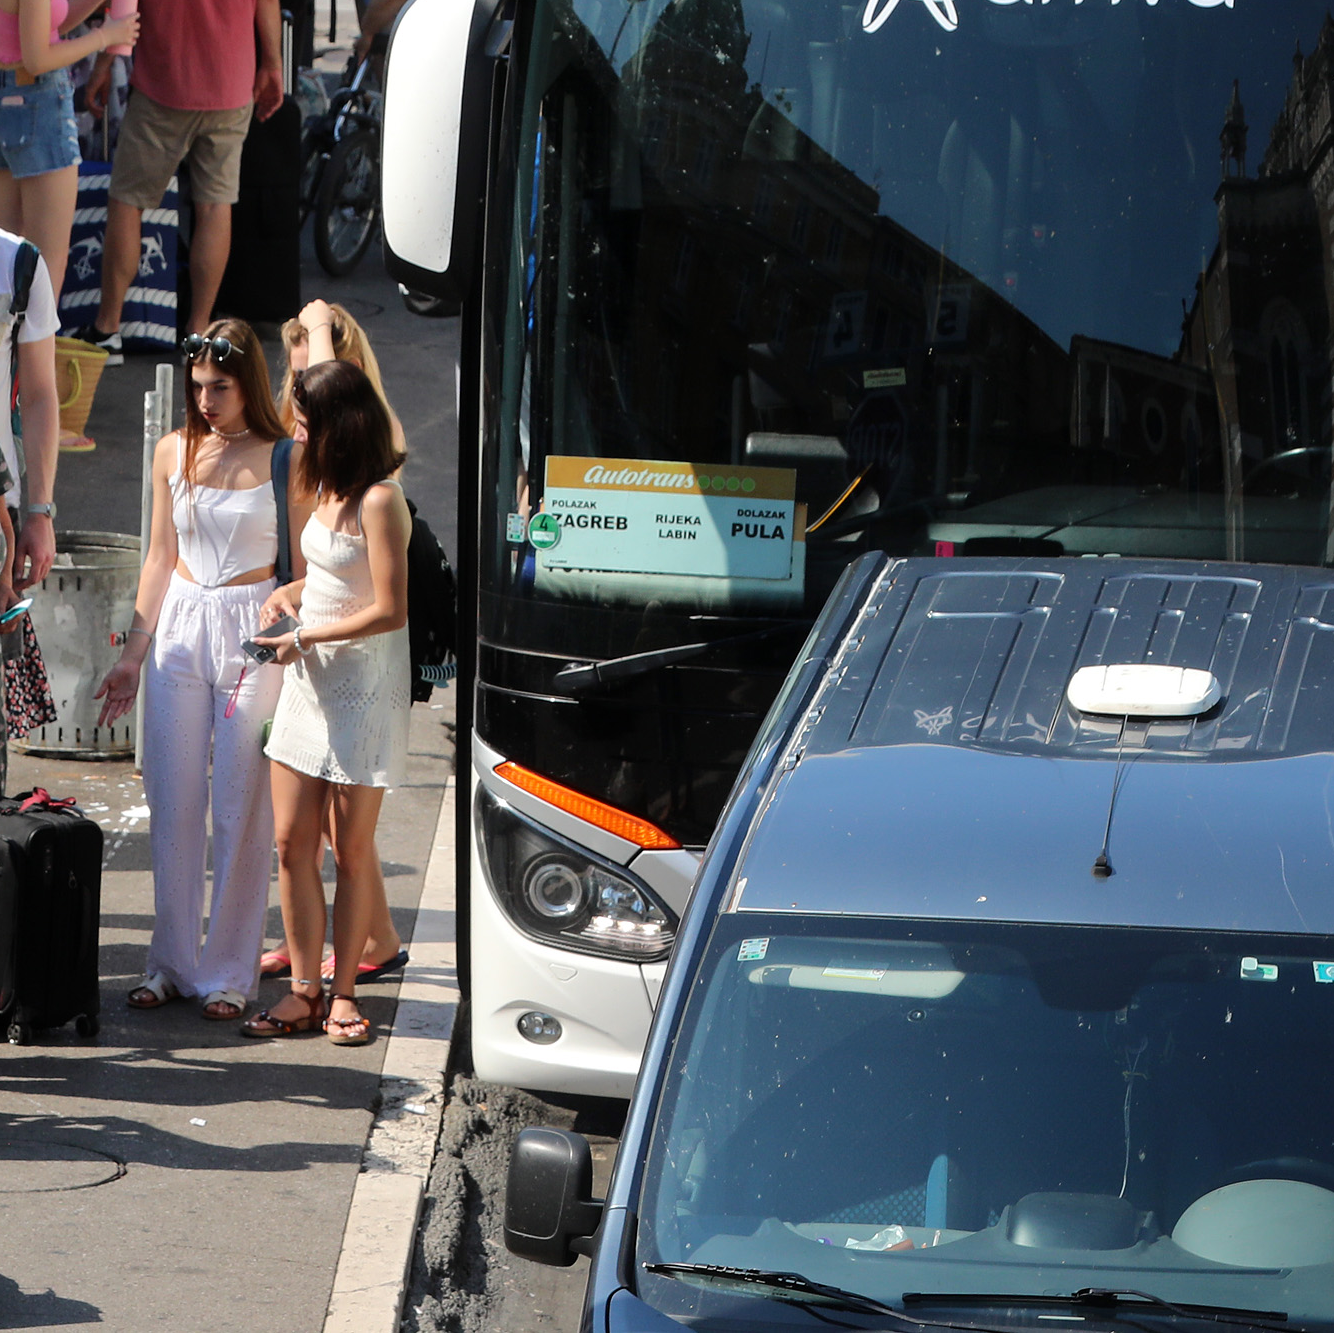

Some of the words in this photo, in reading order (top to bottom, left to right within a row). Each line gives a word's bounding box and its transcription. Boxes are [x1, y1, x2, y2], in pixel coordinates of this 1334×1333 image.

[551, 499, 598, 510] POLAZAK
[736, 508, 787, 520] DOLAZAK
[538, 514, 550, 532] 4
[551, 512, 629, 531] ZAGREB
[654, 513, 702, 526] RIJEKA
[730, 522, 785, 541] PULA
[658, 528, 697, 541] LABIN
